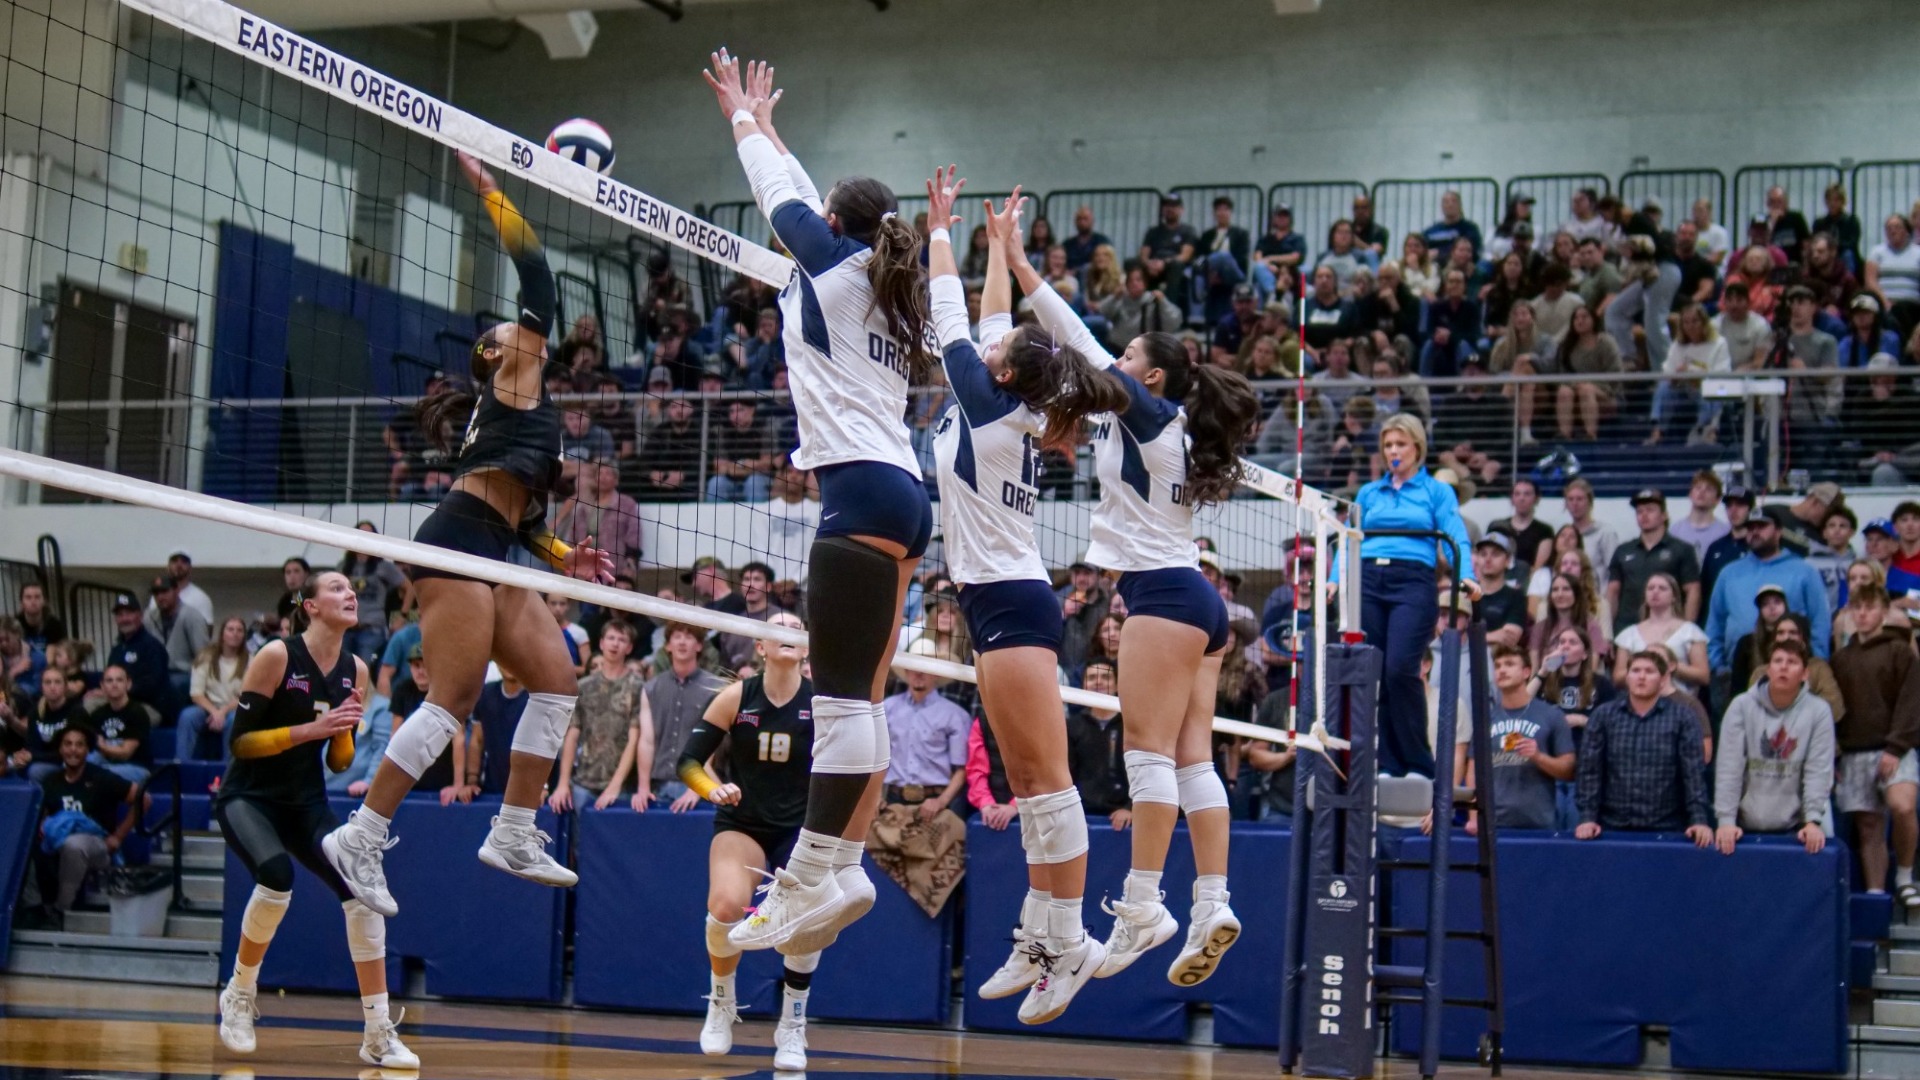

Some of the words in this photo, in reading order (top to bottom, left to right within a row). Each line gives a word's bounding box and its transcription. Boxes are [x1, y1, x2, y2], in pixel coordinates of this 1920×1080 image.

[238, 16, 345, 89] EASTERN
[350, 69, 442, 133] OREGON
[596, 179, 671, 233] EASTERN
[675, 215, 741, 263] OREGON
[1002, 480, 1038, 517] ORE
